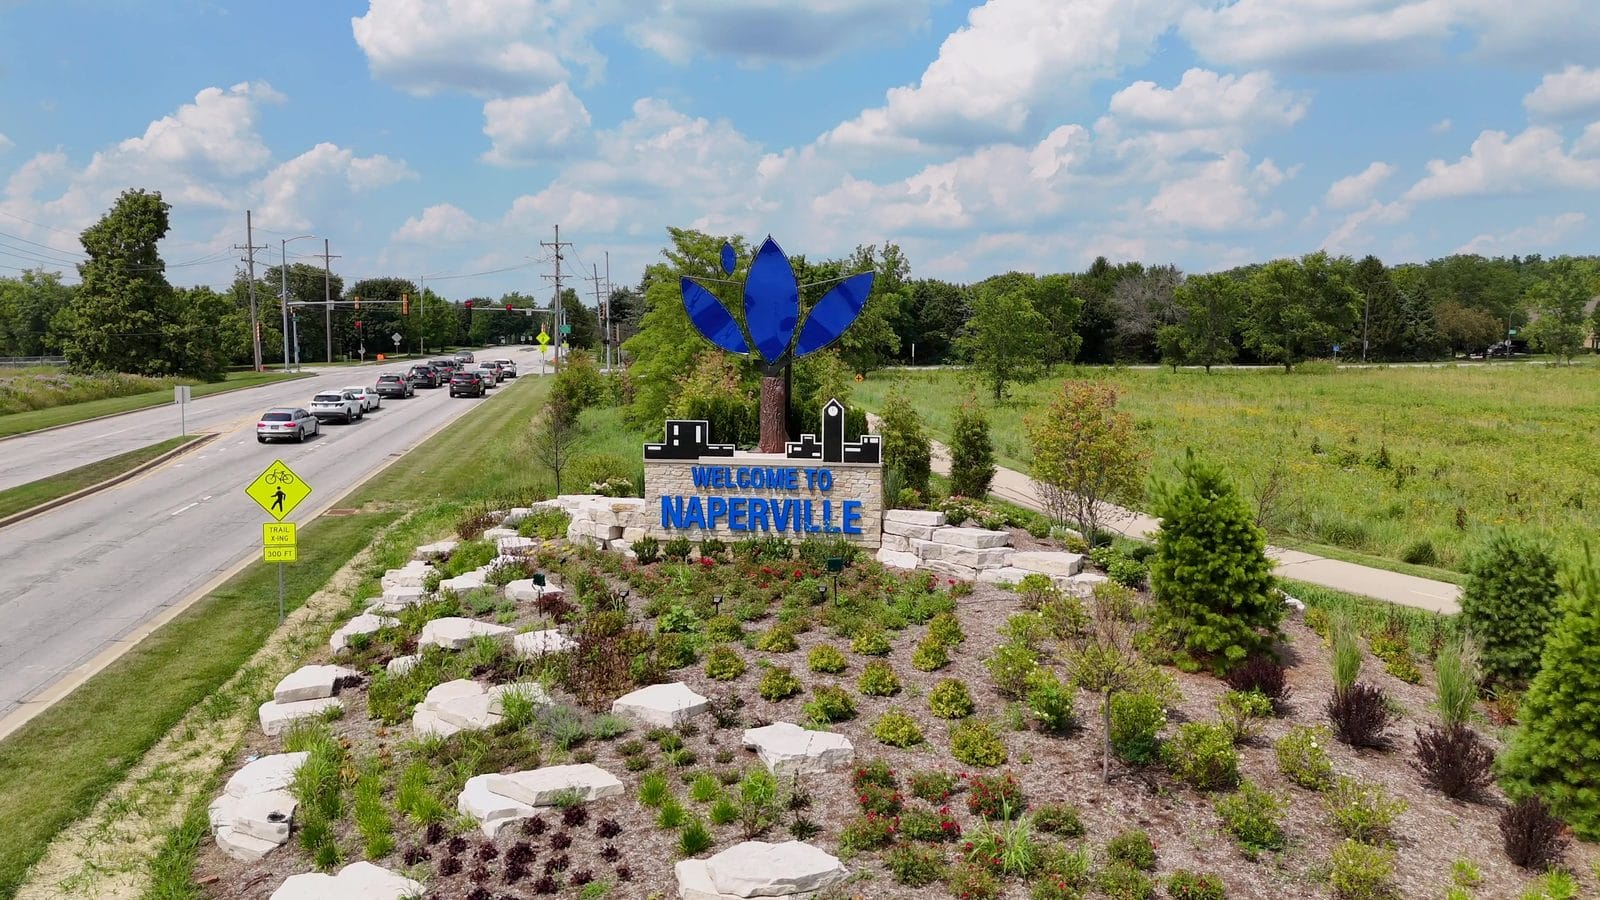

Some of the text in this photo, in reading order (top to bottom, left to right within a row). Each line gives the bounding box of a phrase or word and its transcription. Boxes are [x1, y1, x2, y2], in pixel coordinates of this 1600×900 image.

[691, 466, 832, 491] WELCOME TO
[661, 496, 862, 534] NAPERVILLE
